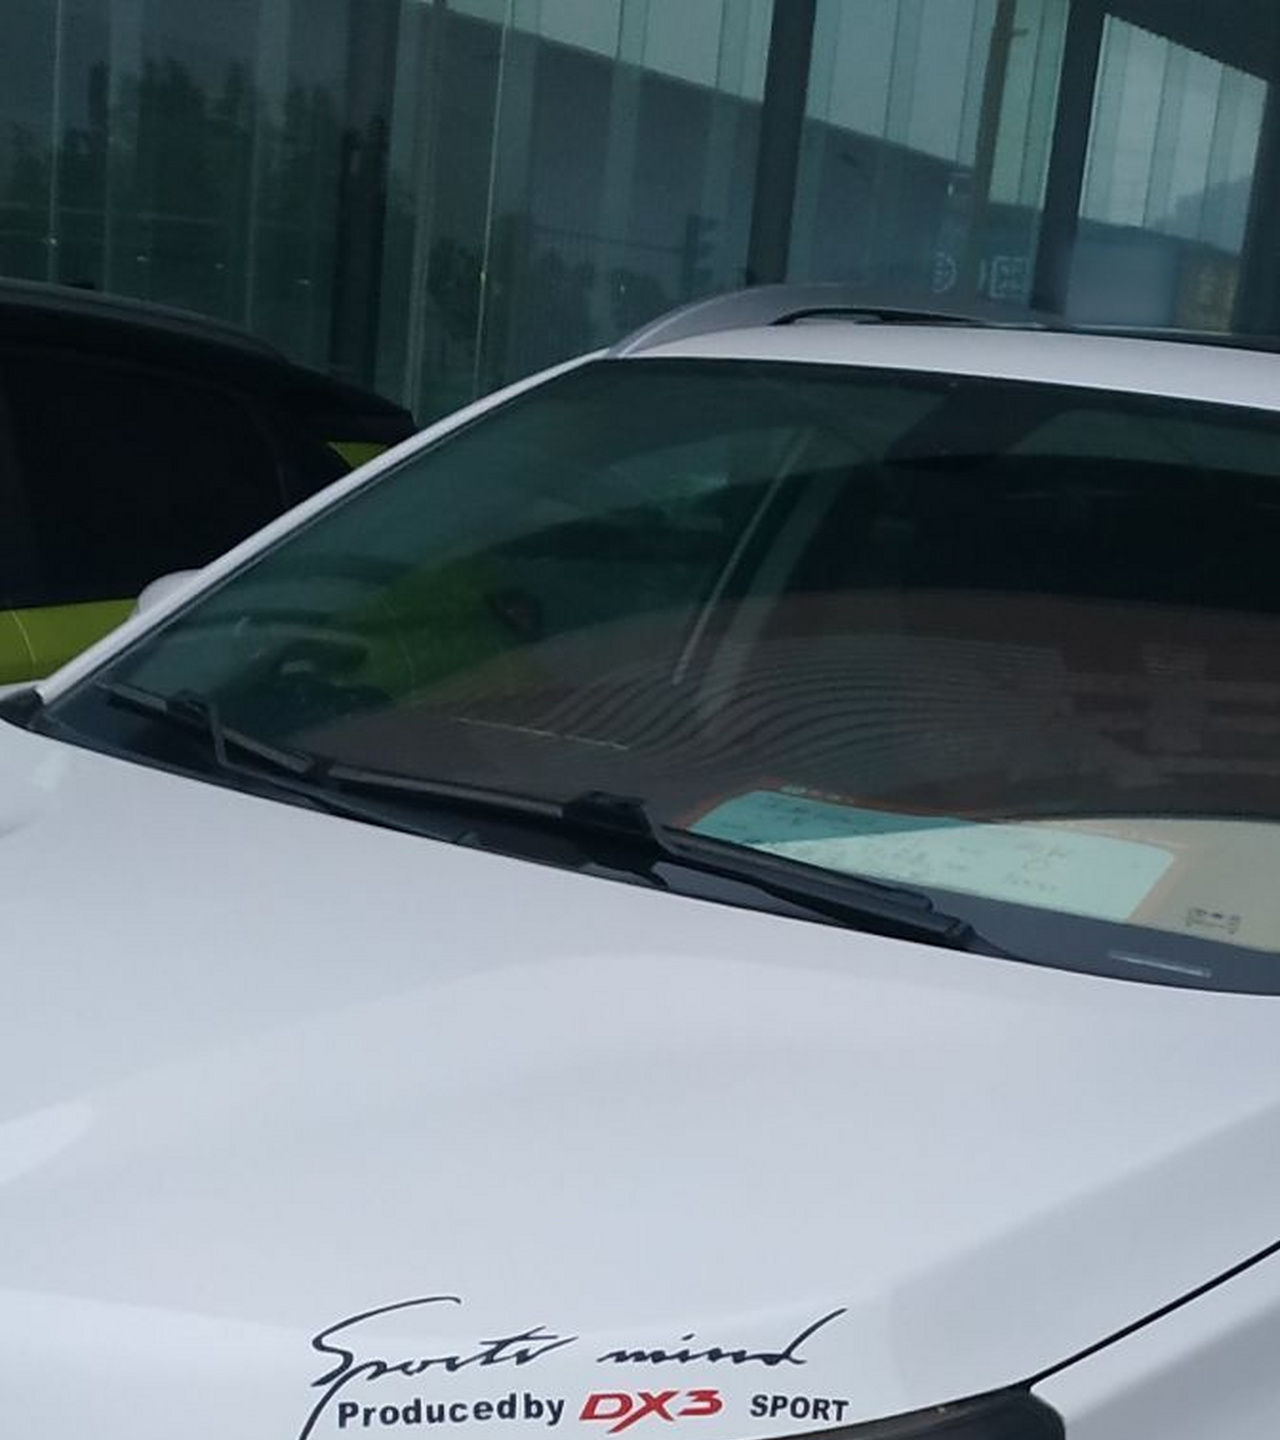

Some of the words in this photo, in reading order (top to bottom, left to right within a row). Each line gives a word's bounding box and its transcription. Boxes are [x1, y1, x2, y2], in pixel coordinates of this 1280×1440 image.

[596, 1308, 847, 1367] mind
[578, 1389, 723, 1434] DX3
[749, 1394, 850, 1422] SPORT
